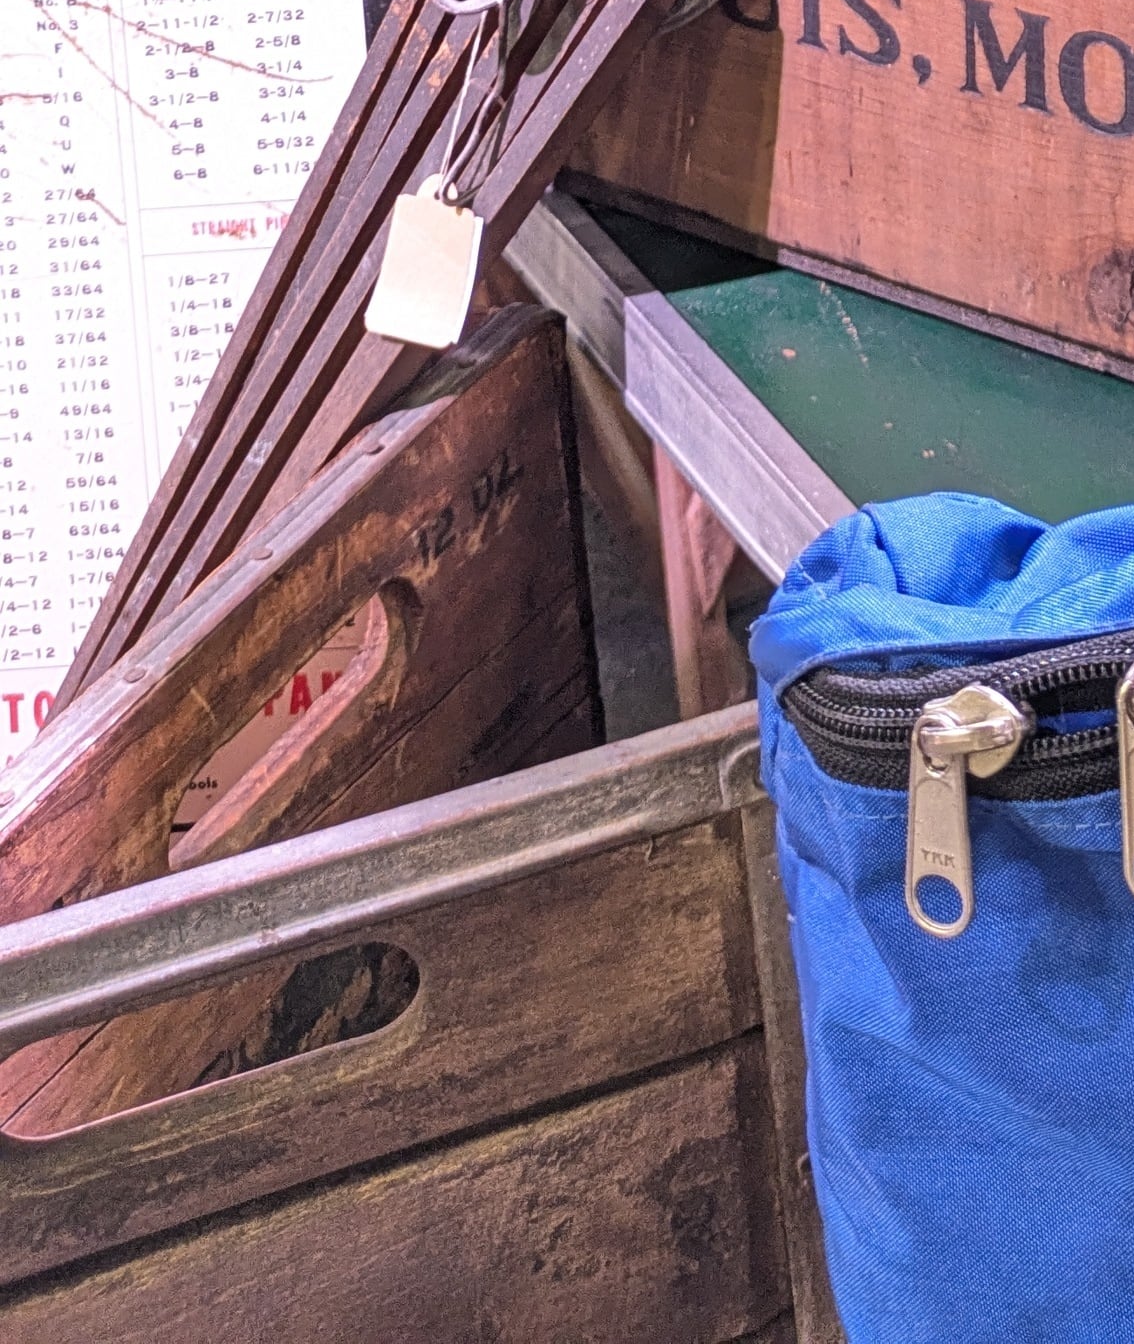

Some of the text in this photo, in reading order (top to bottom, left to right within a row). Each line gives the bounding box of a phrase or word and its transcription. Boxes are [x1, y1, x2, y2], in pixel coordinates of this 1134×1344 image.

[248, 9, 304, 23] 2-7/32
[136, 14, 219, 32] 2-11-1/2
[256, 35, 301, 48] 2-5/8
[55, 43, 63, 54] F
[165, 67, 199, 80] 3-8
[256, 60, 302, 75] 3-1/4
[149, 91, 219, 106] 3-1/2-8
[259, 85, 304, 99] 3-3/4
[59, 115, 69, 127] Q
[169, 117, 203, 129] 4-8
[260, 111, 306, 123] 4-1/4
[172, 143, 205, 156] 5-8
[257, 136, 314, 150] 5-9/32
[61, 164, 75, 174] W
[173, 168, 207, 180] 6-8
[45, 188, 98, 205] 27/64
[46, 212, 98, 224] 27/64
[48, 236, 99, 248] 29/64
[50, 260, 101, 272] 31/64
[170, 273, 229, 288] 1/8-27
[52, 284, 103, 296] 33/64
[171, 297, 232, 312] 1/4-18
[56, 308, 104, 320] 17/32
[171, 322, 234, 339] 3/8-18
[55, 332, 106, 344] 37/64
[57, 355, 108, 369] 21/32
[61, 379, 110, 392] 11/16
[60, 404, 112, 416] 49/64
[65, 427, 114, 440] 13/16
[76, 452, 104, 464] 7/8
[66, 475, 117, 488] 59/64
[70, 499, 119, 512] 15/16
[69, 523, 120, 536] 63/64
[68, 547, 125, 562] 1-3/64
[920, 848, 956, 869] YKK
